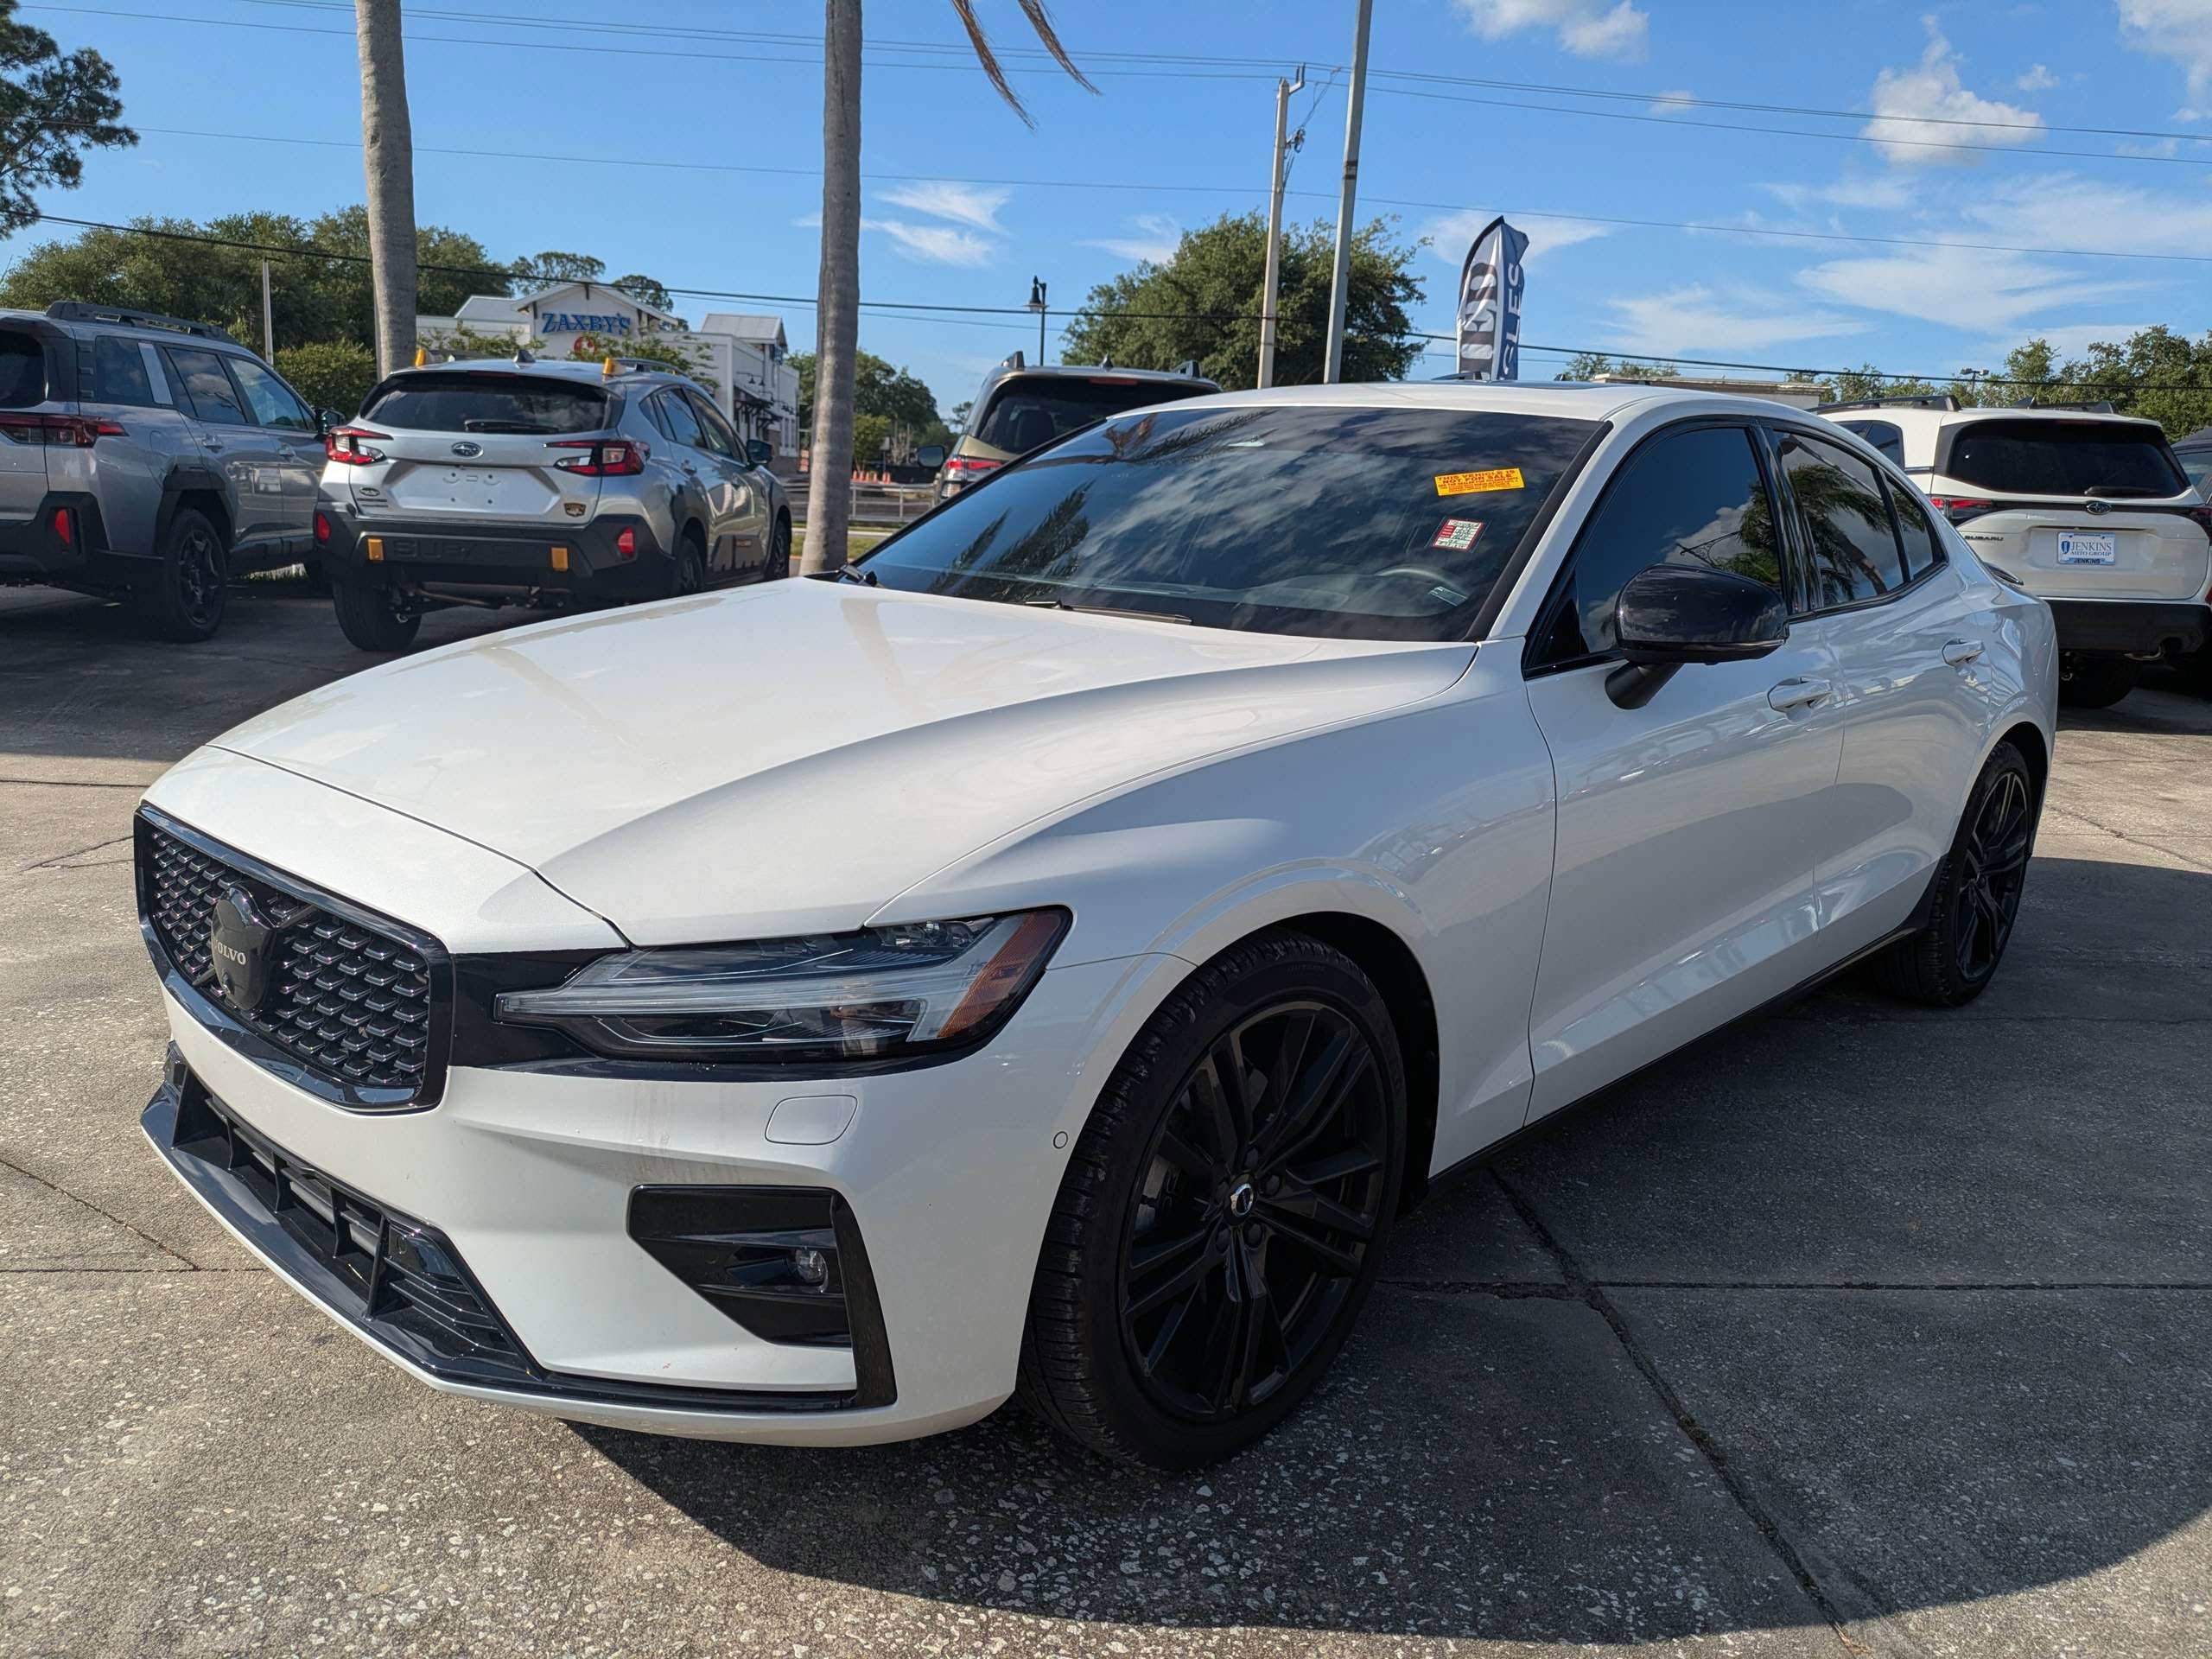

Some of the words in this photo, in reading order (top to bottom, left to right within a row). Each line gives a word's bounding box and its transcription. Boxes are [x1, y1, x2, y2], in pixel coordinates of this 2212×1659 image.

[542, 313, 631, 335] ZAXBY'S
[1502, 263, 1521, 376] CLES
[2072, 541, 2112, 551] JENKINS
